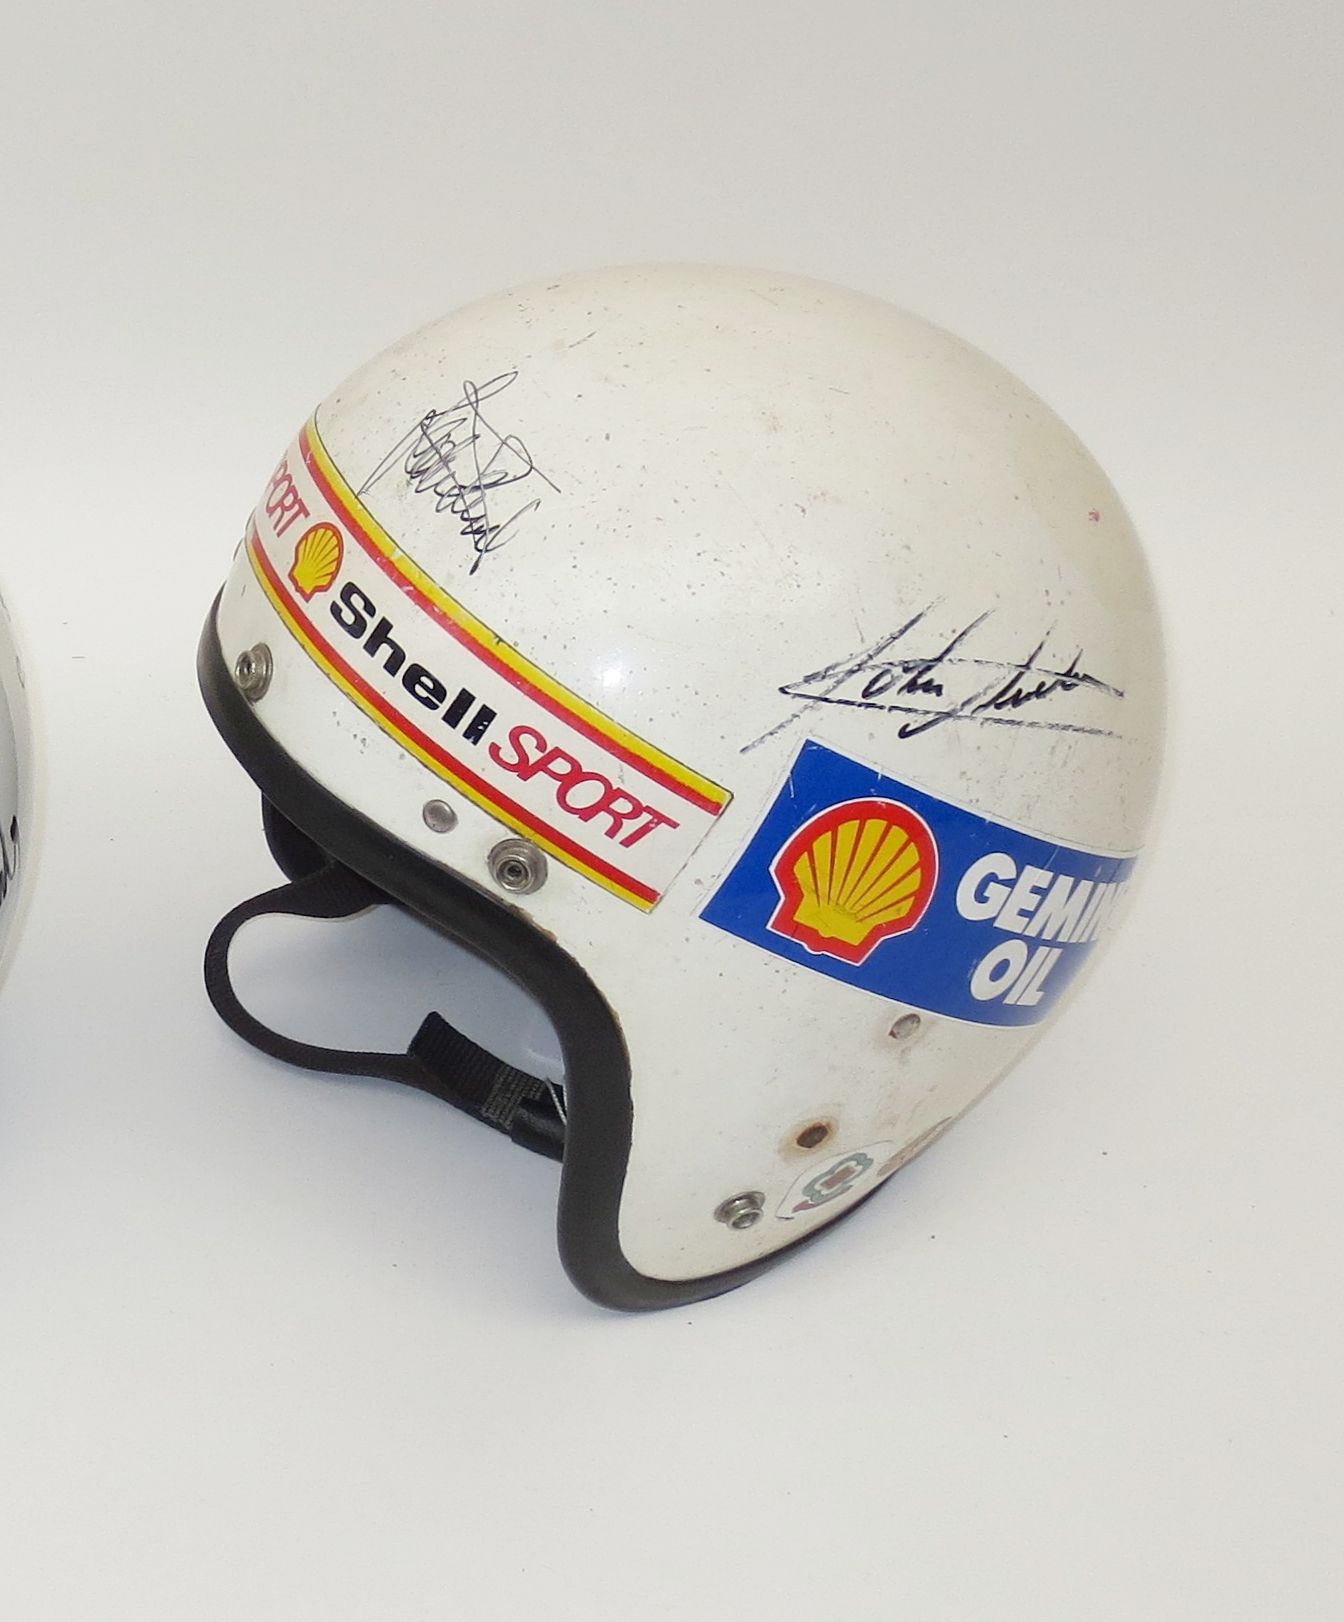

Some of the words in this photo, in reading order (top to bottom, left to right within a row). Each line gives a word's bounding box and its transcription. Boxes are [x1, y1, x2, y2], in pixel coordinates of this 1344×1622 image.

[264, 459, 312, 539] PORT
[329, 581, 498, 747] Shell
[487, 724, 680, 849] SPORT
[969, 938, 1064, 1007] OIL
